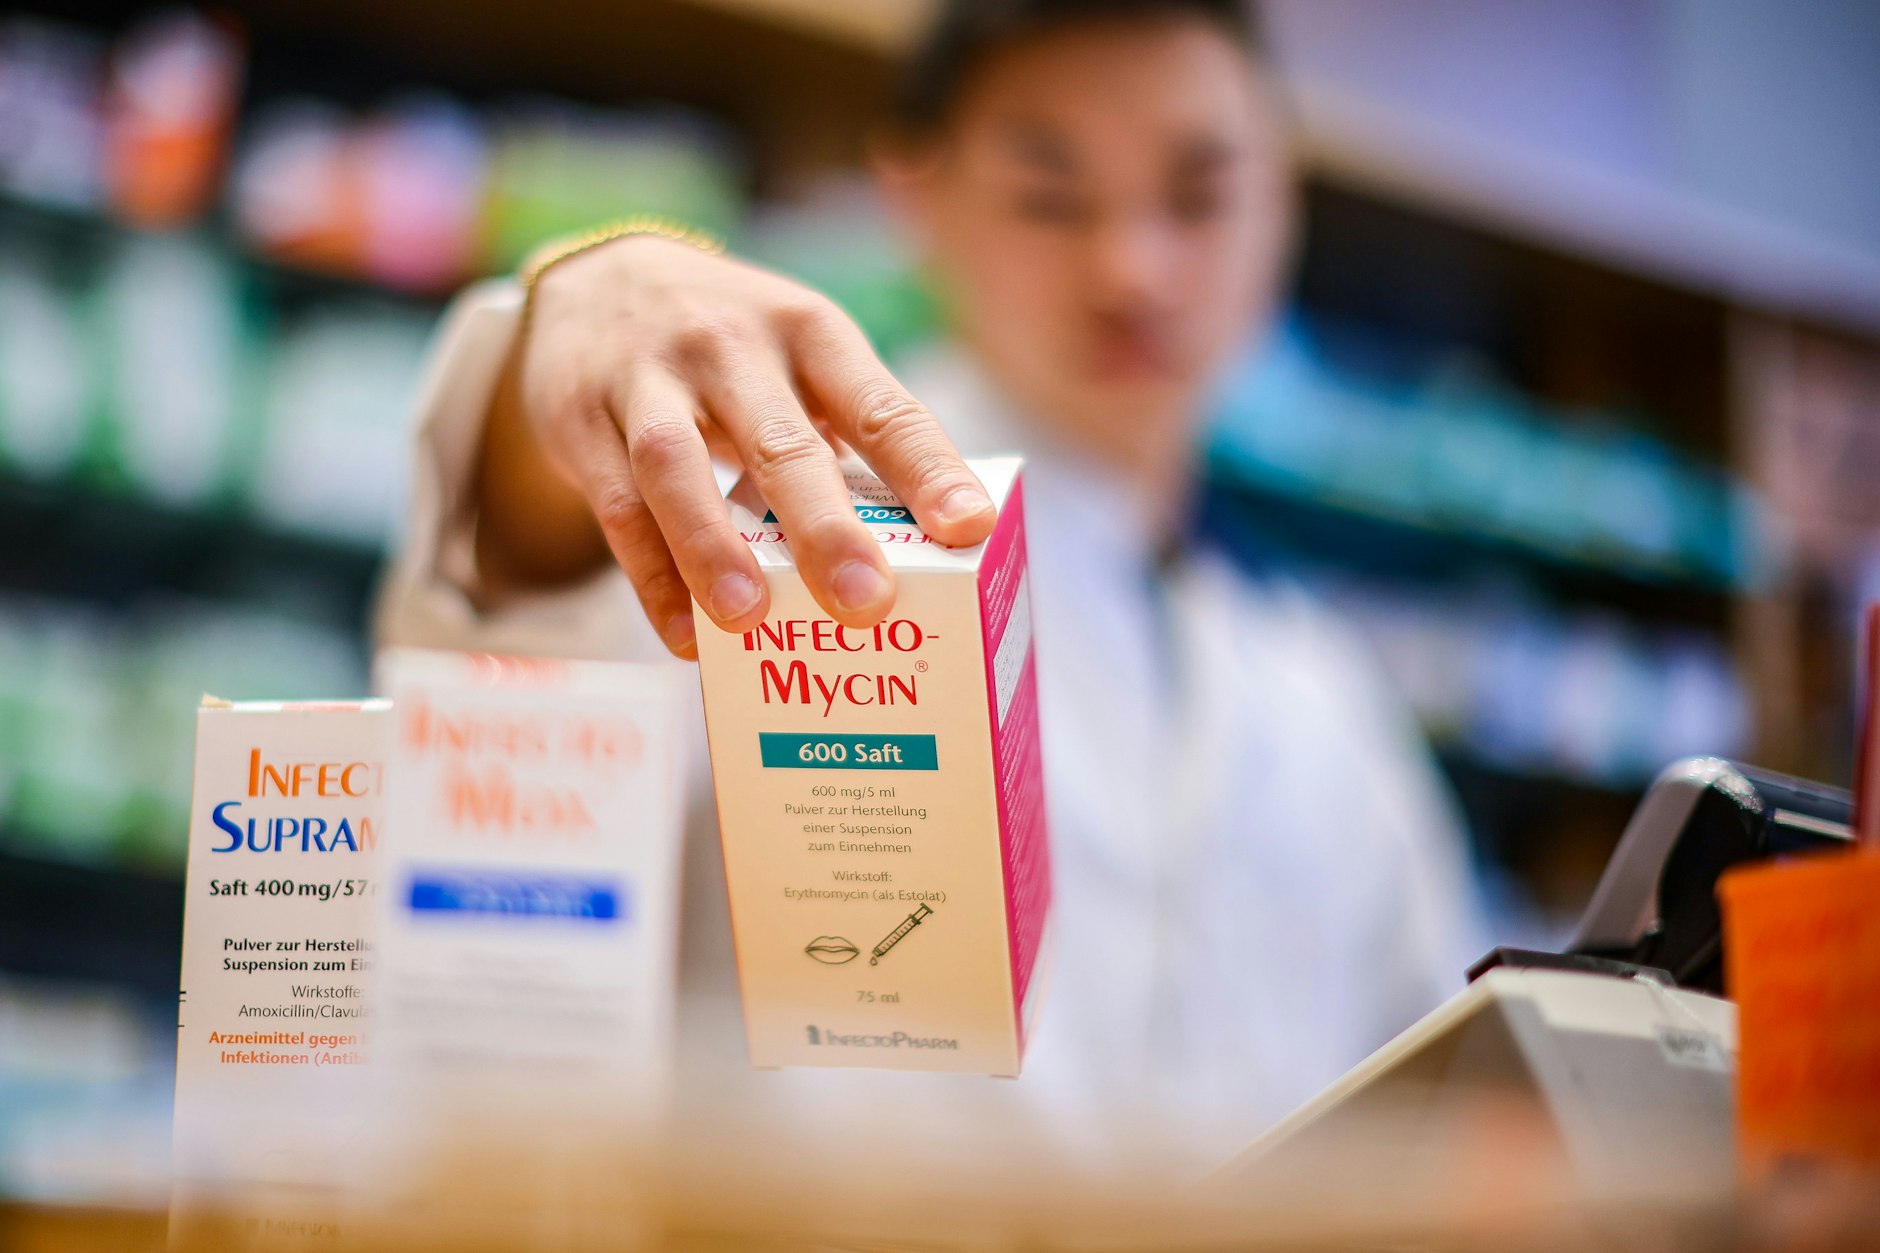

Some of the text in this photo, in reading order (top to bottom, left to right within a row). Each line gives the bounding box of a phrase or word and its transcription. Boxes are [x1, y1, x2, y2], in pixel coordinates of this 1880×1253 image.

[857, 509, 907, 520] 600
[798, 742, 904, 763] 600 Saft
[811, 785, 896, 800] 600 mg/5 ml
[784, 803, 927, 820] Pulver zur Herstellung
[803, 822, 912, 837] einer Suspension
[807, 840, 912, 853] zum Einnehmen
[832, 870, 893, 882] Wirkstoff:
[209, 879, 249, 896] Saft
[255, 879, 295, 897] 400
[784, 887, 947, 904] Erythromycin (als Estolat)
[223, 937, 272, 951] Pulver
[276, 941, 301, 951] zur
[223, 957, 309, 974] Suspension
[313, 961, 346, 971] zum
[856, 990, 900, 1004] 75 ml
[209, 1031, 304, 1045] Arzneimittel
[309, 1035, 357, 1049] gegen
[221, 1050, 309, 1064] Infektionen
